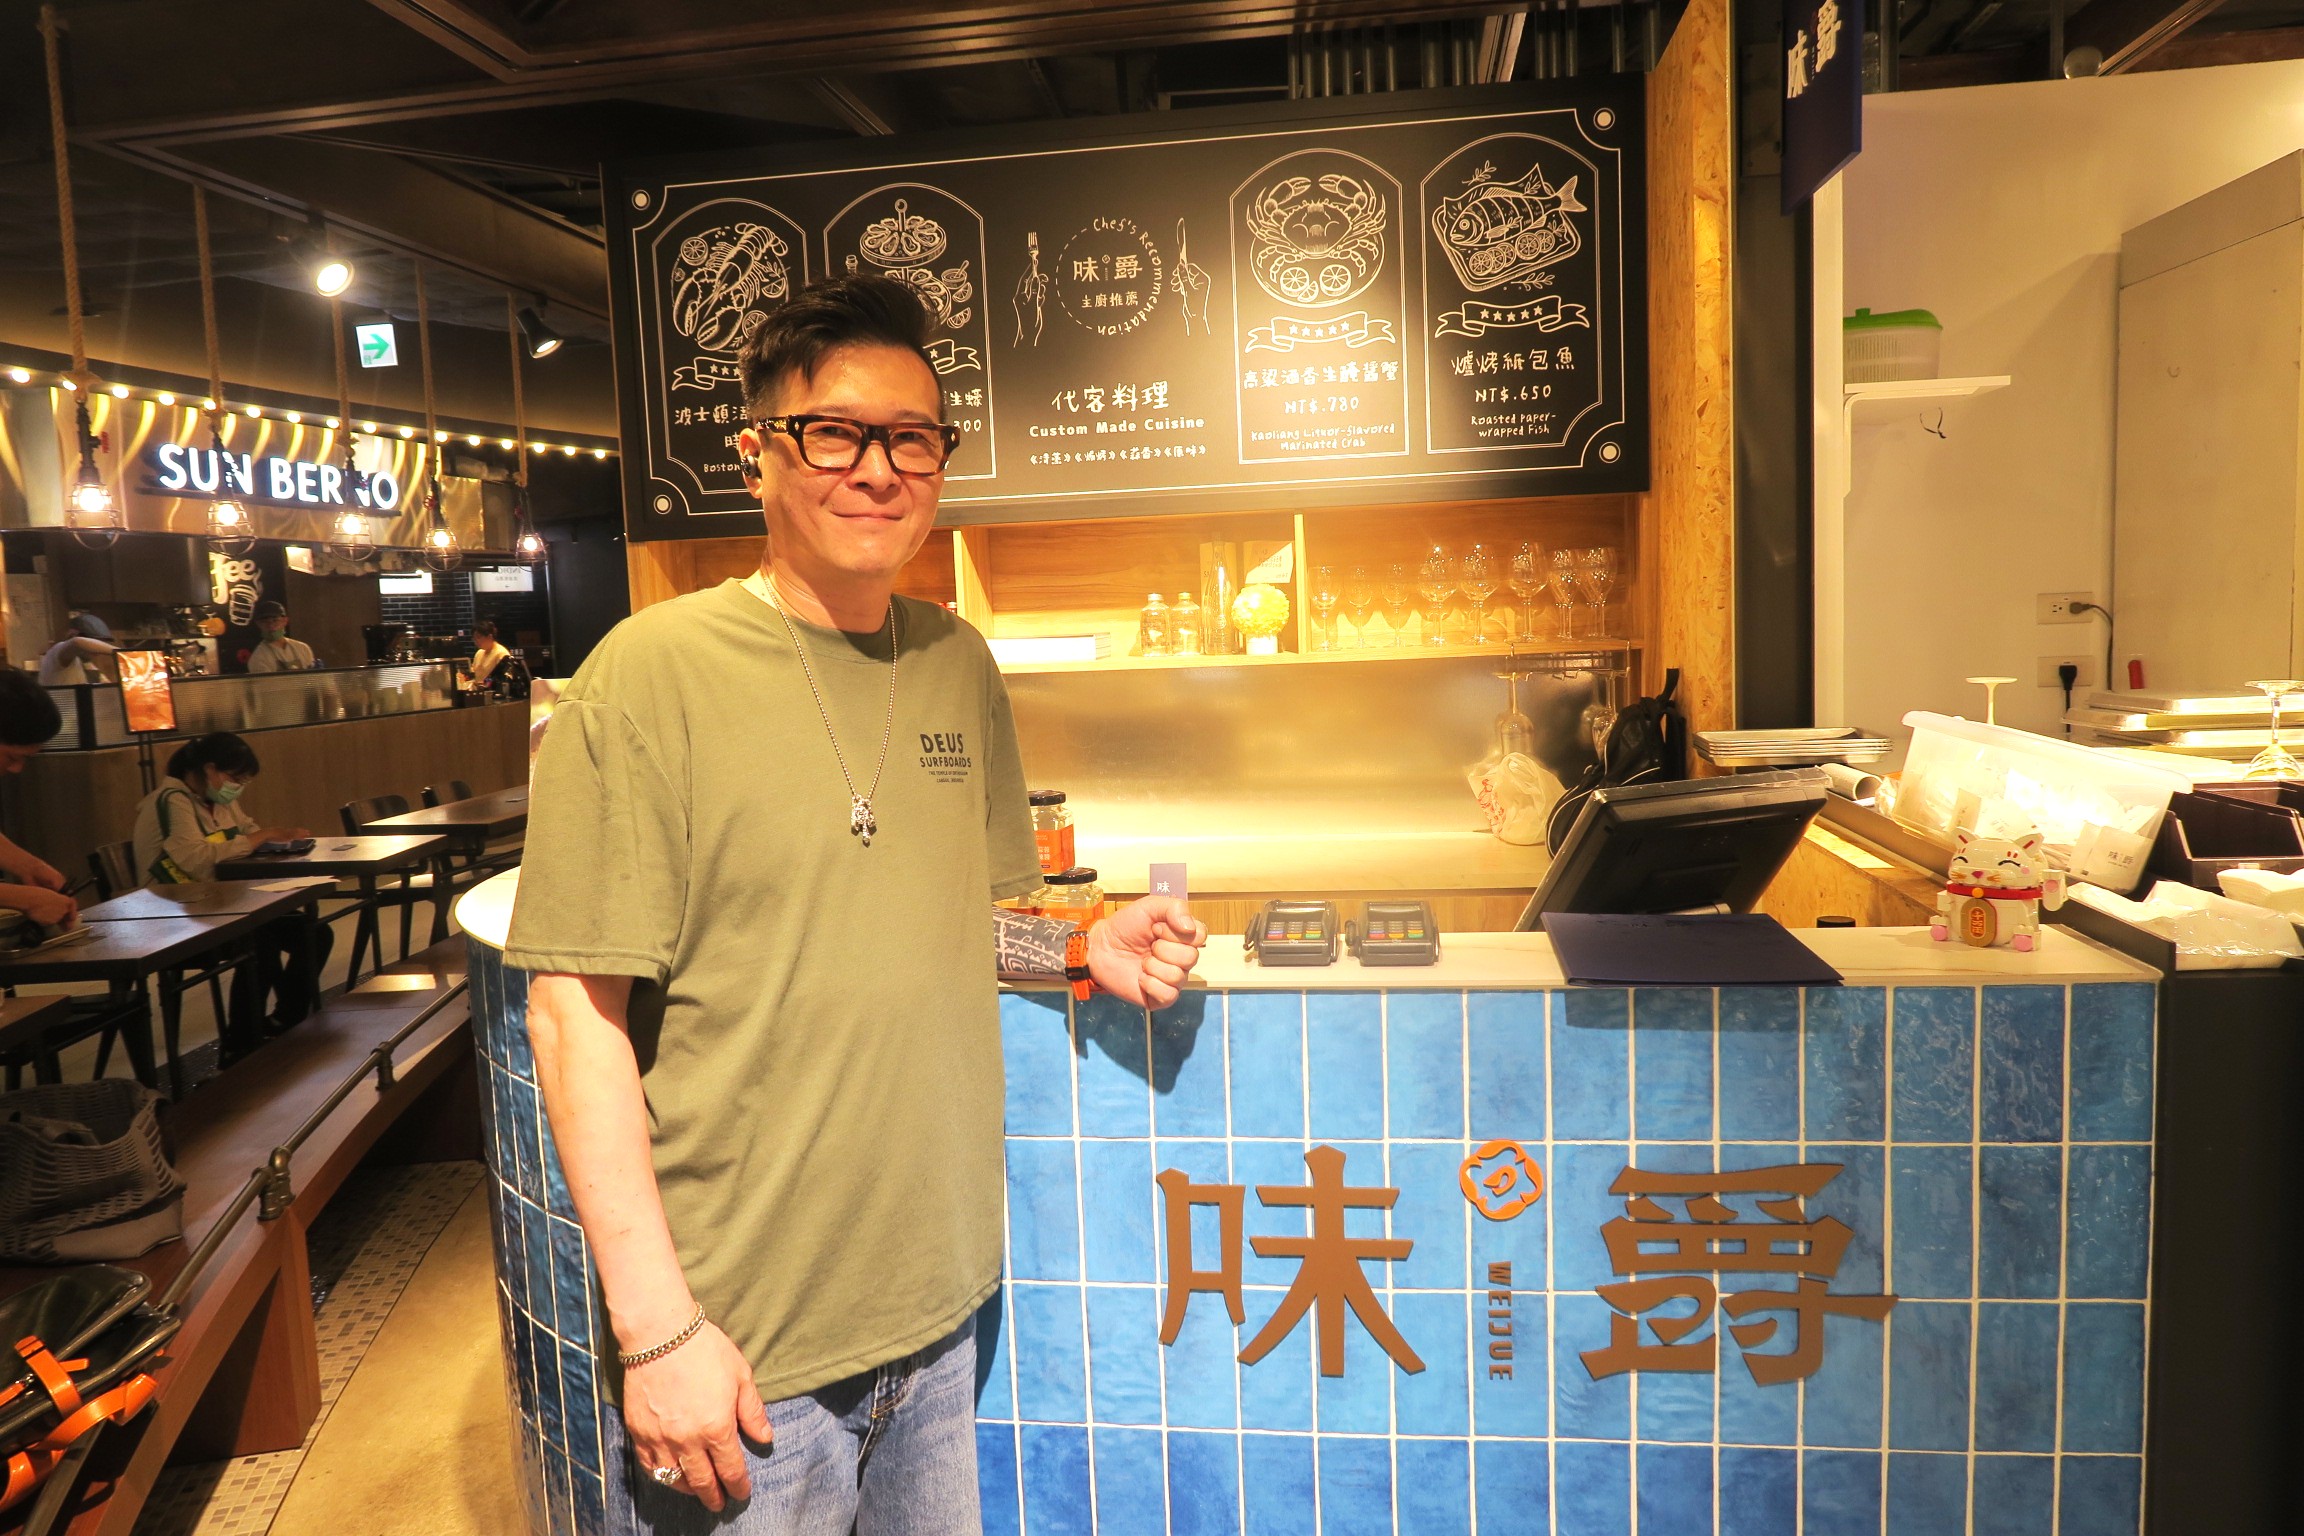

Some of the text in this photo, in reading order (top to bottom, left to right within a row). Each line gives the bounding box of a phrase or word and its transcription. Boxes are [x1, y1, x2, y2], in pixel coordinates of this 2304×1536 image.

[1073, 254, 1143, 282] 味爵
[1093, 217, 1163, 336] Chef's Recommendation
[1081, 291, 1139, 308] 主廚推薦
[1451, 346, 1575, 377] 爐烤紙包魚
[1051, 380, 1170, 413] 代客料理
[1029, 416, 1205, 438] Custom Made Cuisine
[1471, 413, 1516, 426] Roasted
[1478, 424, 1550, 438] wrapped Fish
[1341, 436, 1367, 449] Crab
[158, 443, 254, 495] SUN
[919, 732, 964, 754] DEUS
[919, 756, 972, 768] SURFBOARDS
[1156, 880, 1171, 894] 味
[1156, 1144, 1899, 1388] 味爵
[1488, 1260, 1513, 1381] WEIJUE
